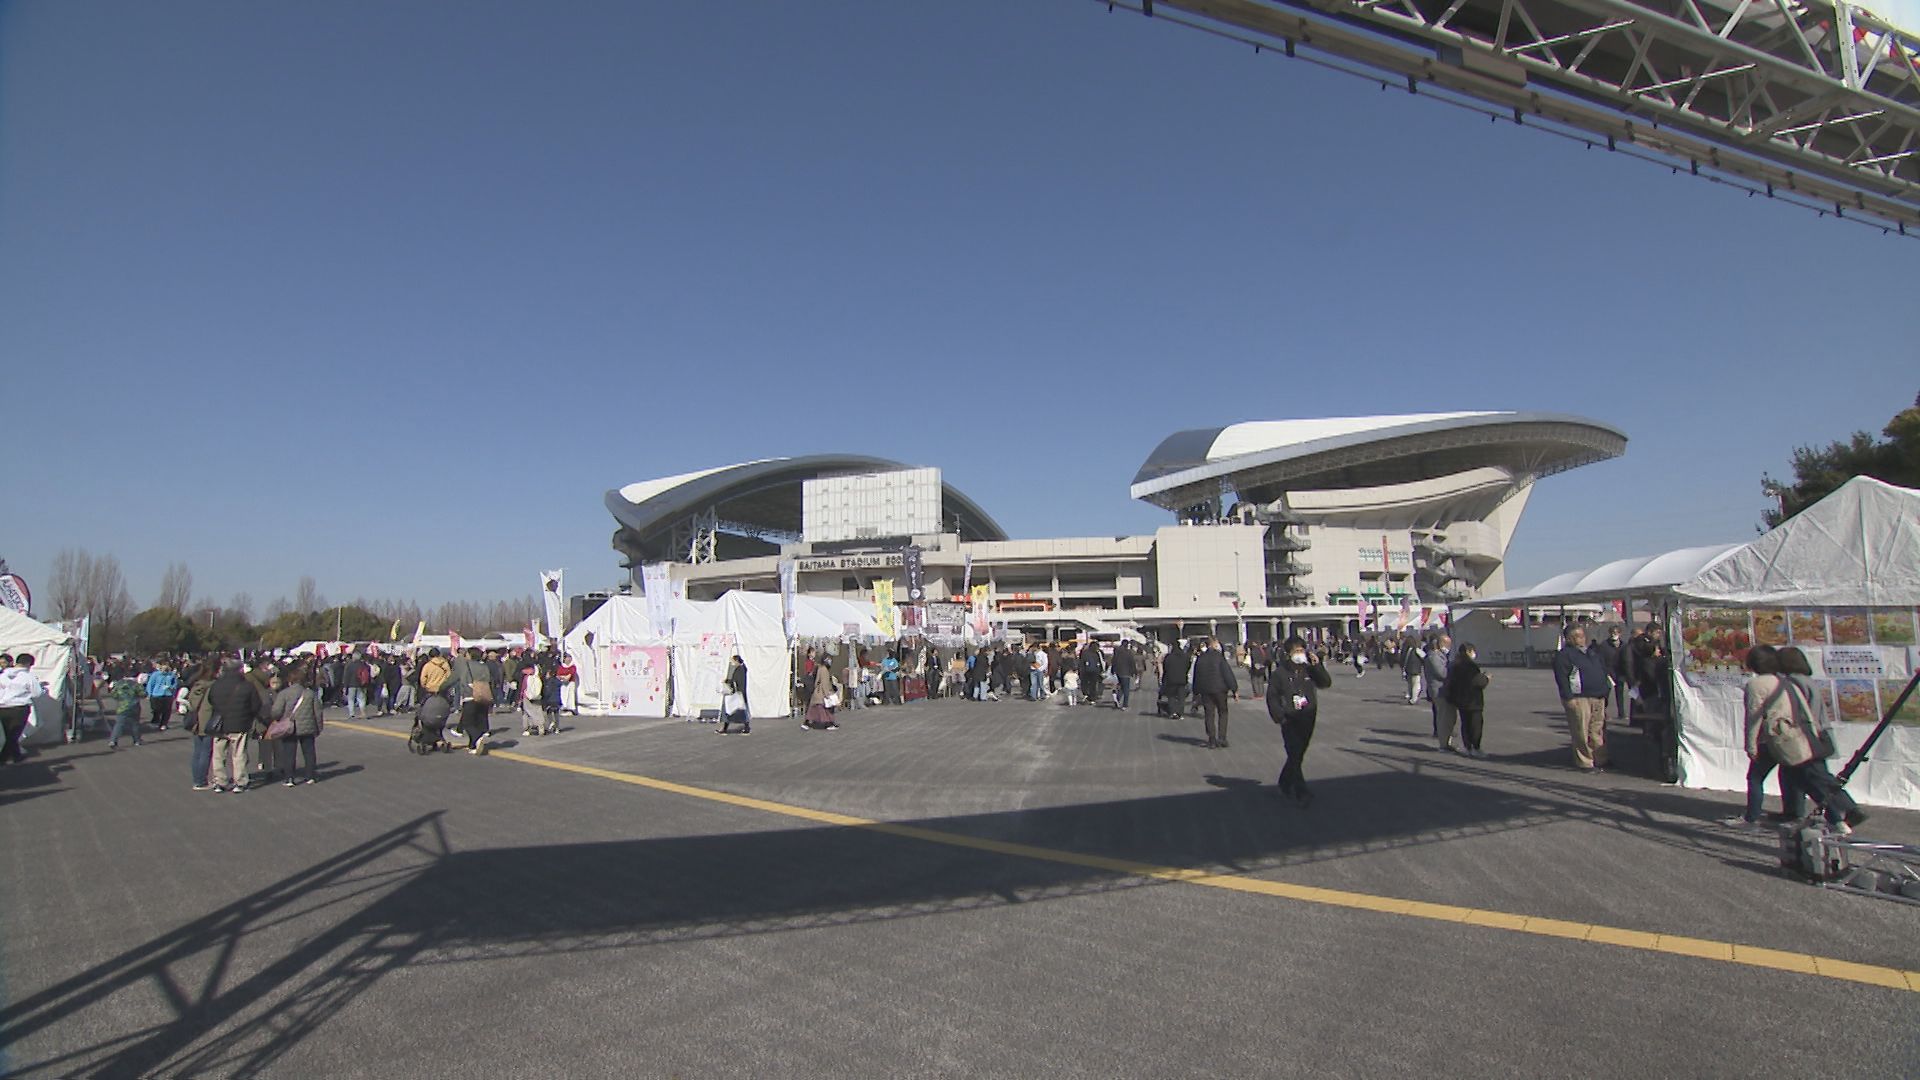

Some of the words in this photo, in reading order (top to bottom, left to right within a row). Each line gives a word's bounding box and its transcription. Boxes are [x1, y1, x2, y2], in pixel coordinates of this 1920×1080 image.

[799, 560, 836, 570] SAITAMA
[840, 557, 881, 568] STADIUM
[885, 555, 902, 566] 200
